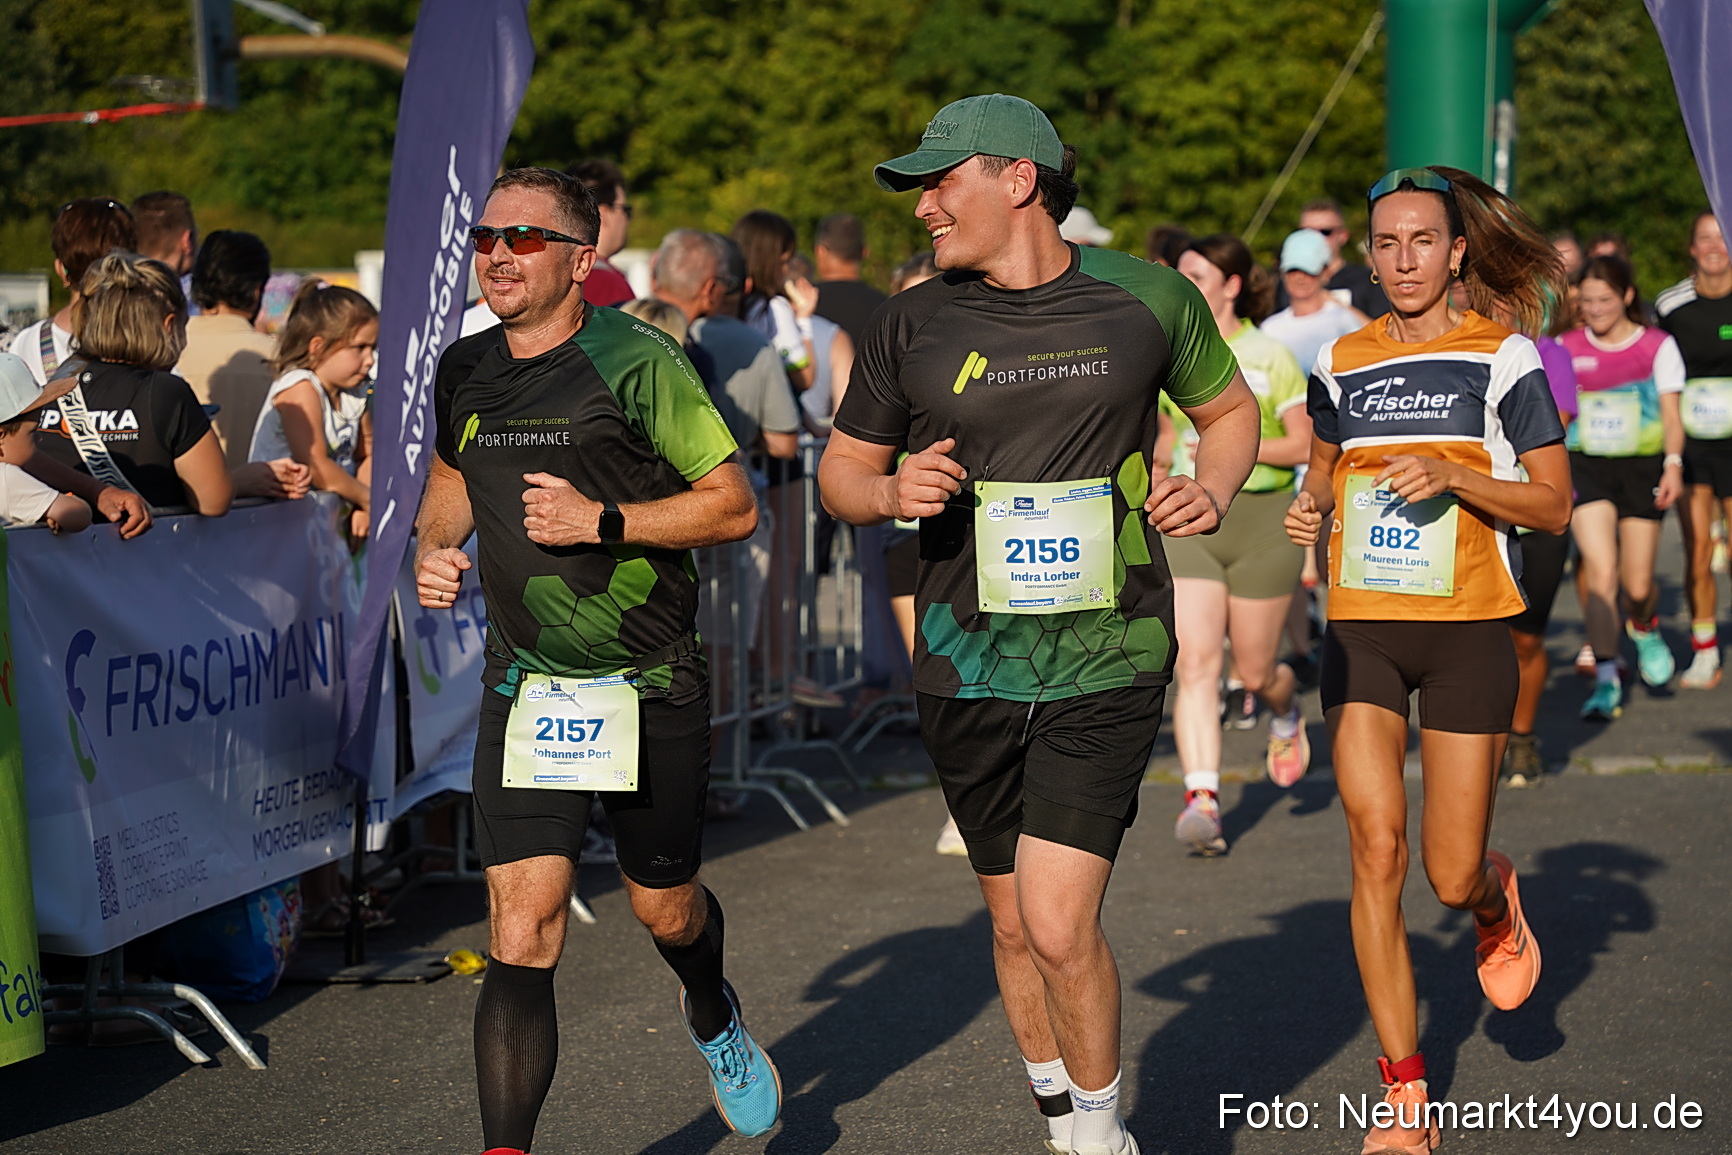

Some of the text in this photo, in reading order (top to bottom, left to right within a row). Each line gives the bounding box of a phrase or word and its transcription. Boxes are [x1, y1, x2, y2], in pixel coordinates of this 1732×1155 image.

[404, 191, 474, 475] AUTOMOBILE
[631, 323, 677, 357] SUCCESS
[1027, 346, 1109, 362] secure your success
[987, 360, 1109, 385] PORTFORMANCE
[1363, 390, 1459, 412] Fischer
[38, 408, 139, 430] PTKA
[506, 417, 570, 428] secure your success
[1369, 410, 1450, 422] AUTOMOBILE
[477, 431, 571, 448] PORTFORMANCE
[1008, 507, 1050, 518] Firmenlauf
[1369, 525, 1420, 551] 882
[1004, 537, 1080, 564] 2156
[1363, 552, 1430, 567] Maureen Loris
[1010, 570, 1081, 582] Indra Lorber
[535, 717, 605, 743] 2157
[532, 747, 612, 759] Johannes Port
[252, 778, 300, 817] HEUTE
[252, 817, 307, 861] MORGEN
